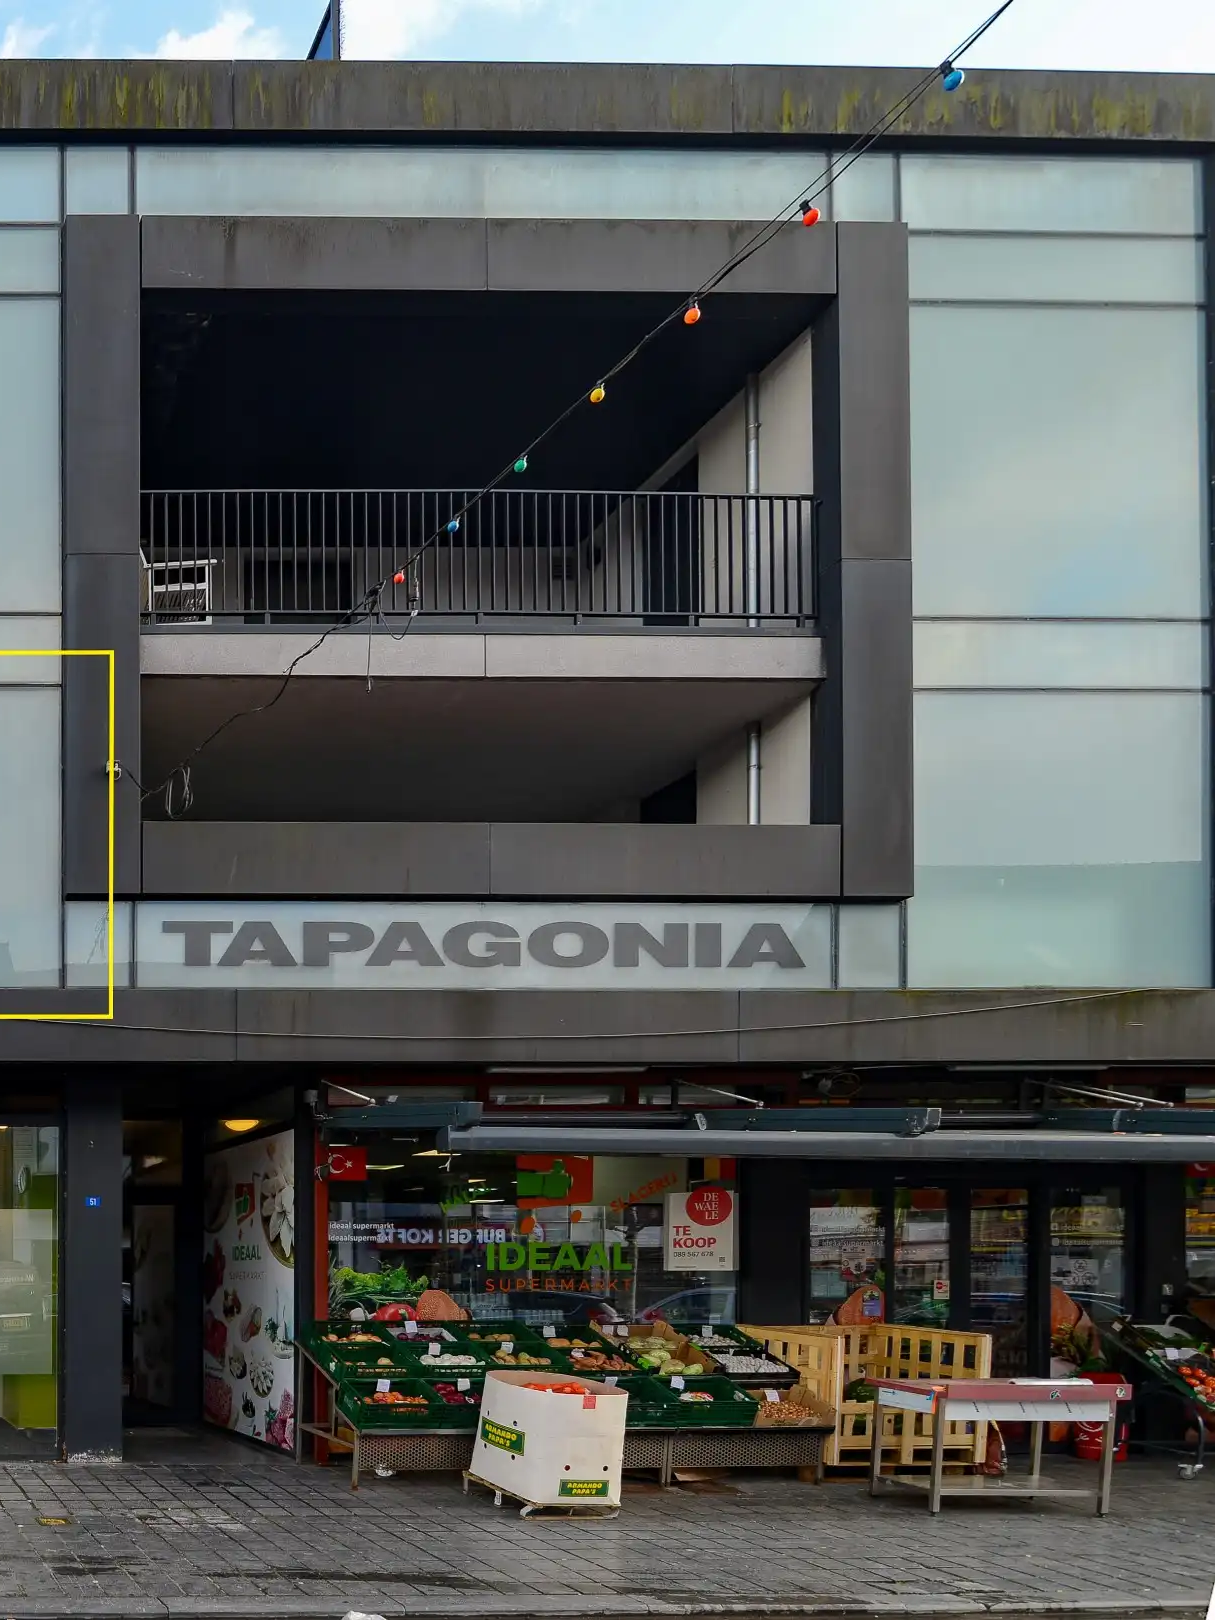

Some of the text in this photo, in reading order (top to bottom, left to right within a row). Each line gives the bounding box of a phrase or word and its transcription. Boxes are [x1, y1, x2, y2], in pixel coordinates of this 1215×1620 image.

[162, 920, 807, 968] TAPAGONIA
[89, 1197, 97, 1206] 51
[704, 1192, 719, 1202] DE
[695, 1202, 719, 1211] WAE
[705, 1211, 719, 1220] LE
[672, 1225, 691, 1236] TE
[672, 1237, 717, 1249] KOOP
[232, 1244, 262, 1261] IDEAAL
[486, 1242, 634, 1271] IDEAAL
[486, 1278, 633, 1292] SUPERMARKT
[485, 1424, 517, 1441] ARMANDO
